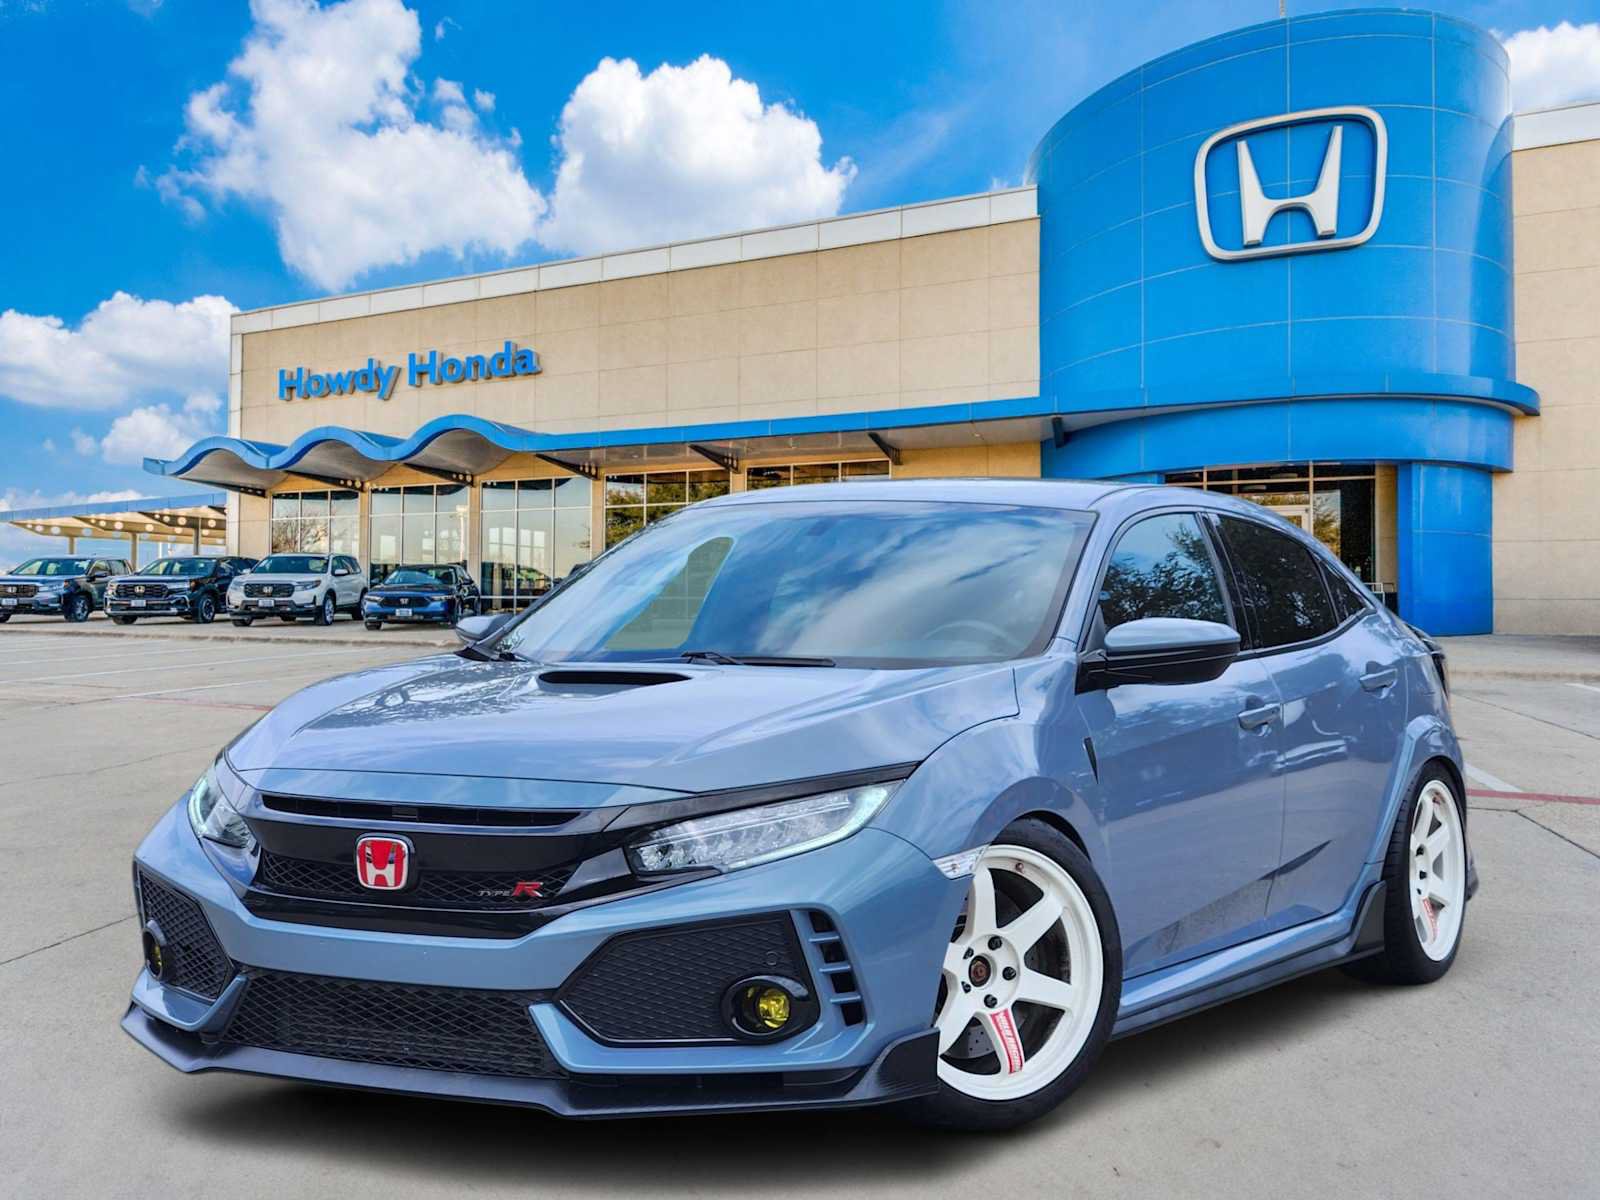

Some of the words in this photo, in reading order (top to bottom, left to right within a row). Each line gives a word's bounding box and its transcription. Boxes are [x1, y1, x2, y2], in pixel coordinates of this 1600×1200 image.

[278, 358, 401, 400] Howdy
[407, 341, 541, 387] Honda
[479, 889, 511, 897] TYPE
[511, 881, 544, 897] R
